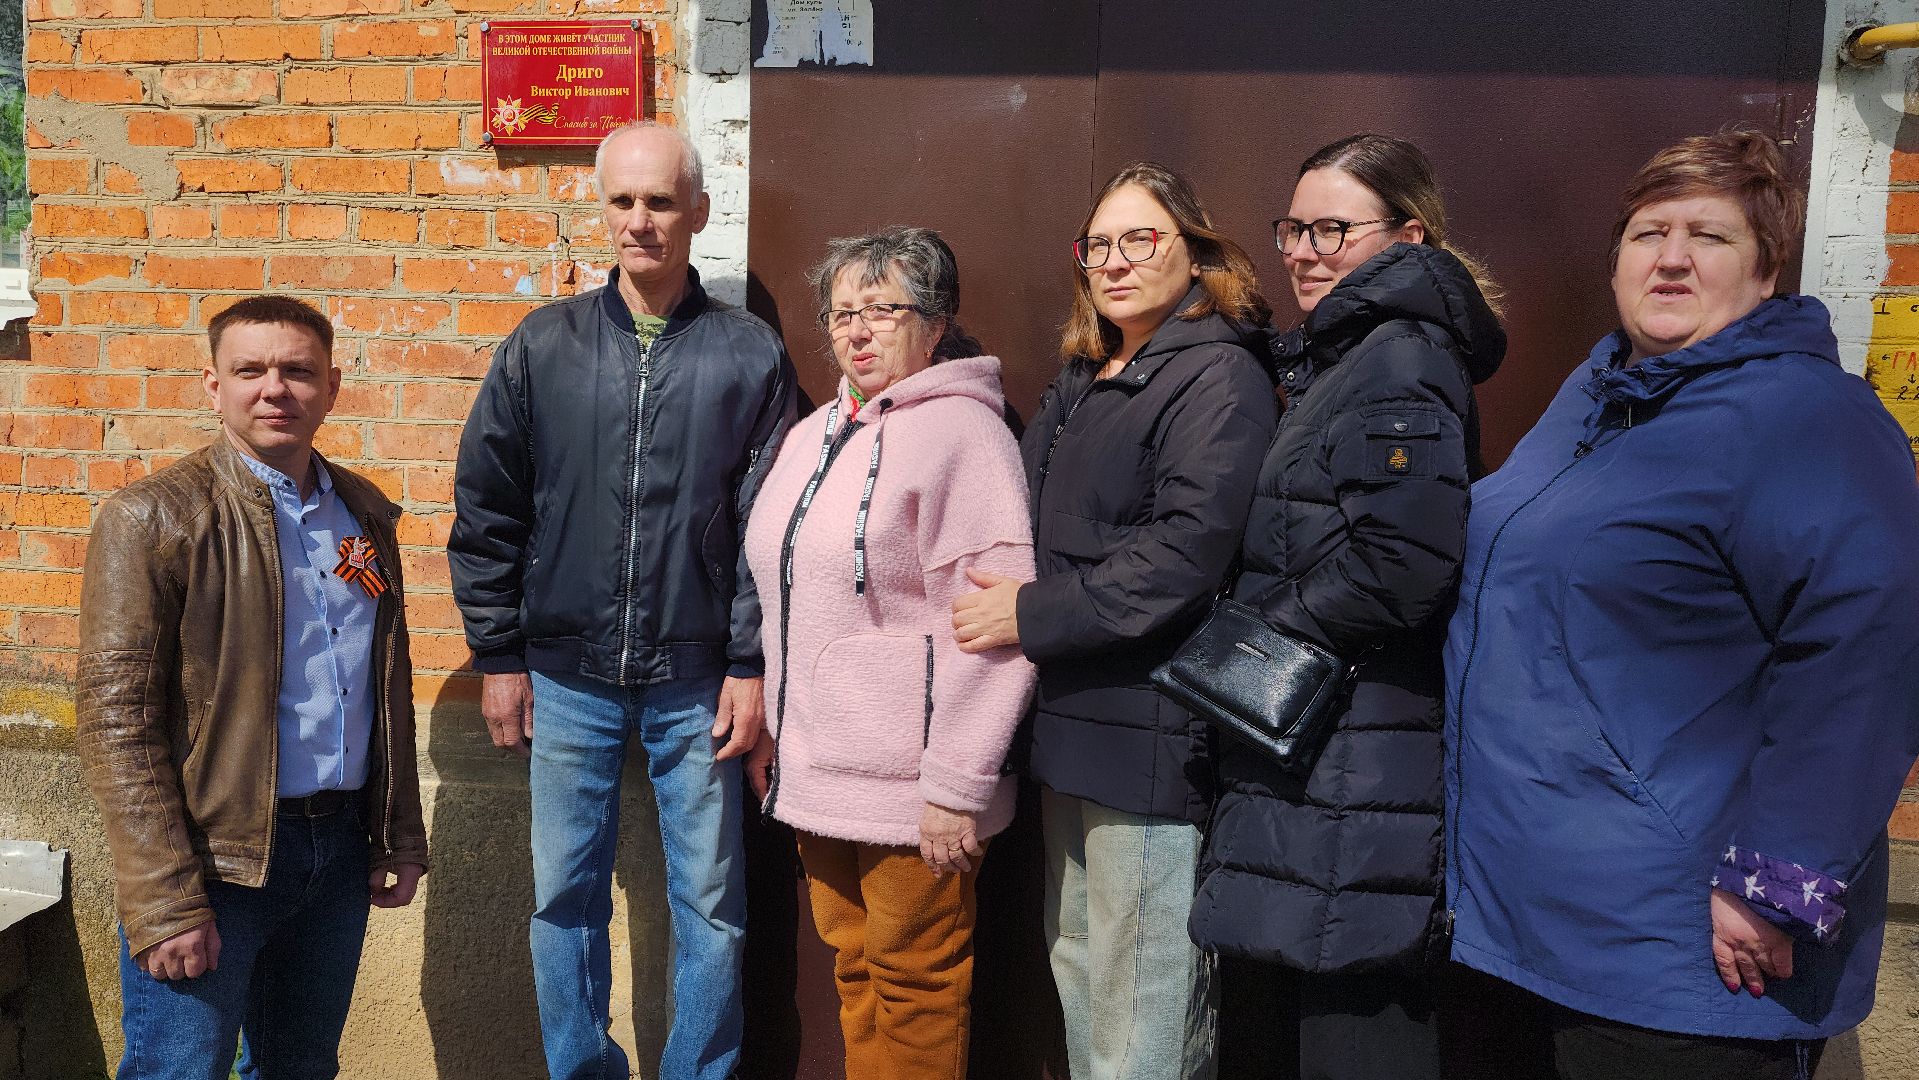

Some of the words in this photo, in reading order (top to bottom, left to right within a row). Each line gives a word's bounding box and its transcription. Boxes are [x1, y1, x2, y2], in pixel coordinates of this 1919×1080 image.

[492, 45, 531, 56] ВЕЛИКОЙ
[533, 44, 600, 55] ОТЕЧЕСТВЕННОЙ
[602, 44, 632, 55] ВОЙНЫ
[498, 35, 503, 43] В
[504, 35, 528, 43] ЭТОМ
[529, 34, 552, 44] ДОМЕ
[552, 33, 581, 43] ЖИВЁТ
[583, 34, 626, 43] УЧАСТНИК
[555, 64, 604, 83] Дриго
[531, 86, 572, 99] Виктор
[574, 85, 630, 97] Иванович
[554, 116, 589, 129] Спасибо
[589, 121, 598, 129] за
[825, 408, 838, 435] FASHION
[818, 444, 830, 472] FASHION
[802, 480, 818, 508] FASHION
[855, 509, 867, 538] FASHION
[855, 549, 865, 582] FASHION
